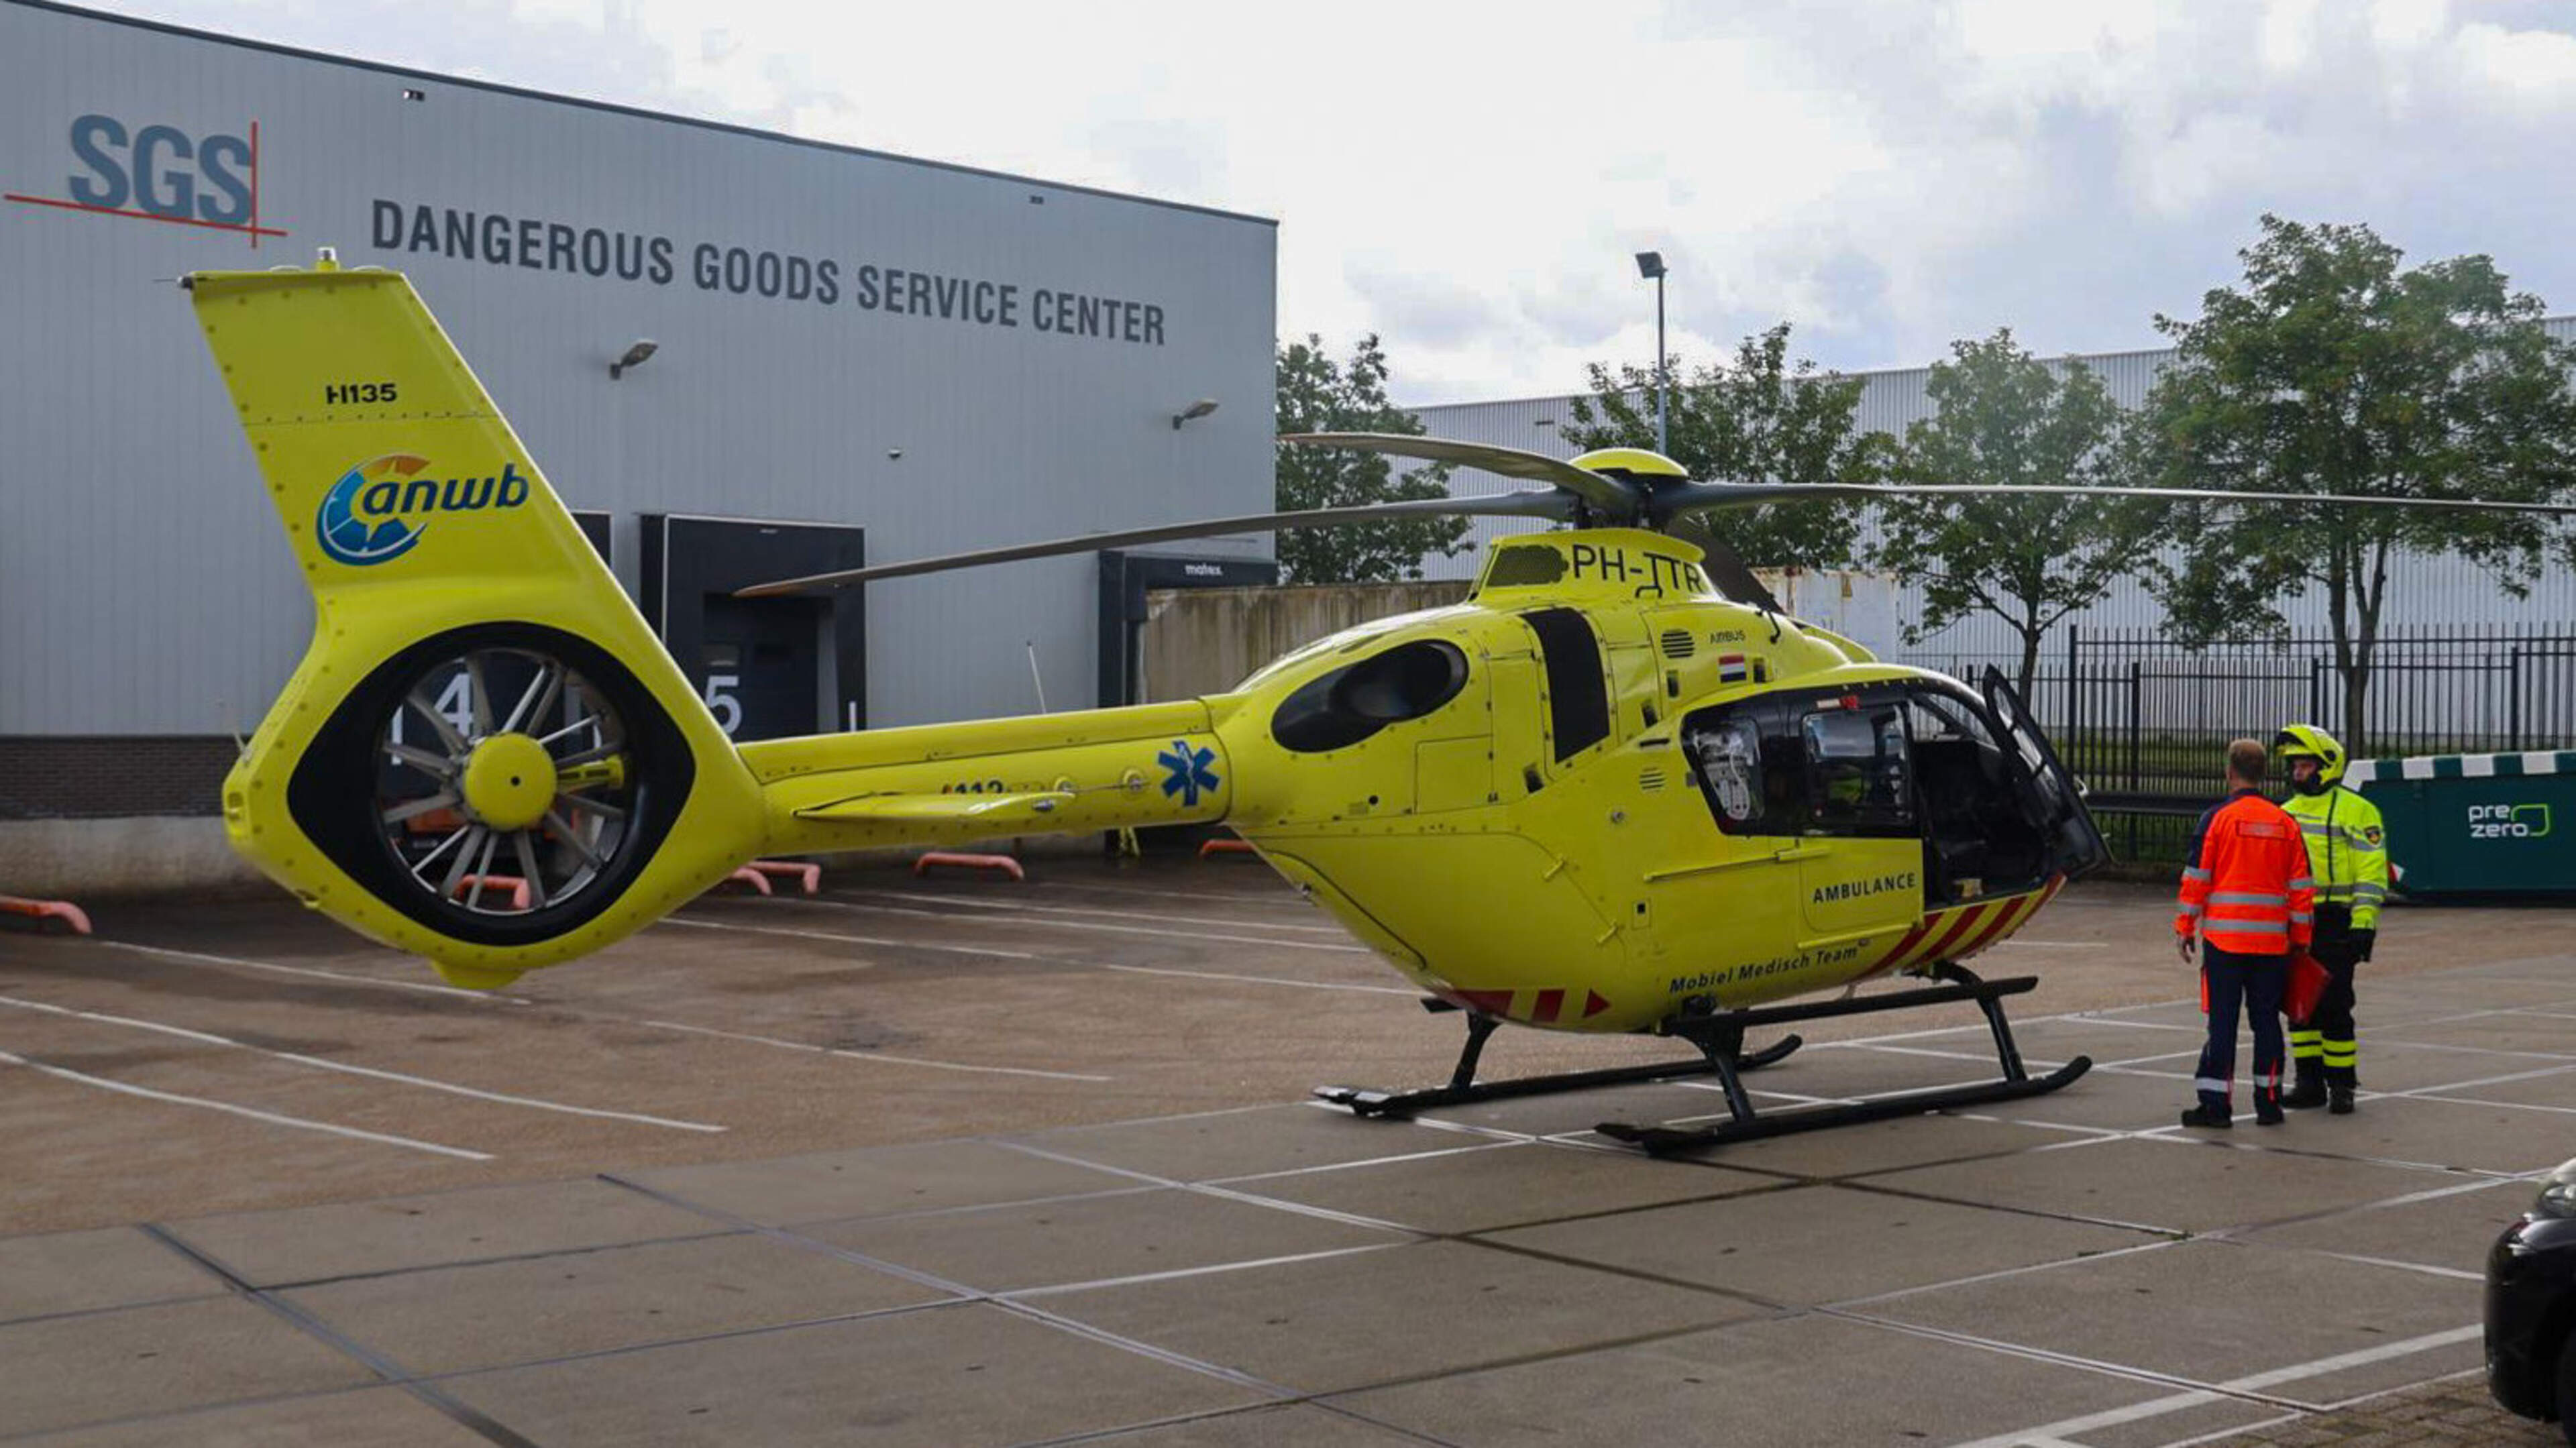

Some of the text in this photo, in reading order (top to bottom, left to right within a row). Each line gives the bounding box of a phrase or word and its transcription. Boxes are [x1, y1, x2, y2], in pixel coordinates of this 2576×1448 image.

[68, 114, 256, 227] SGS
[372, 199, 1165, 345] DANGEROUS GOODS SERVICE CENTER
[326, 383, 398, 404] H135
[362, 463, 529, 515] anwb
[1573, 544, 1704, 594] PH-TTR
[434, 673, 476, 740] 4
[706, 675, 742, 735] 5
[2469, 804, 2510, 823] pre
[2470, 823, 2528, 838] zero
[1813, 873, 1916, 903] AMBULANCE
[1669, 946, 1858, 993] Mobiel Medisch Team
